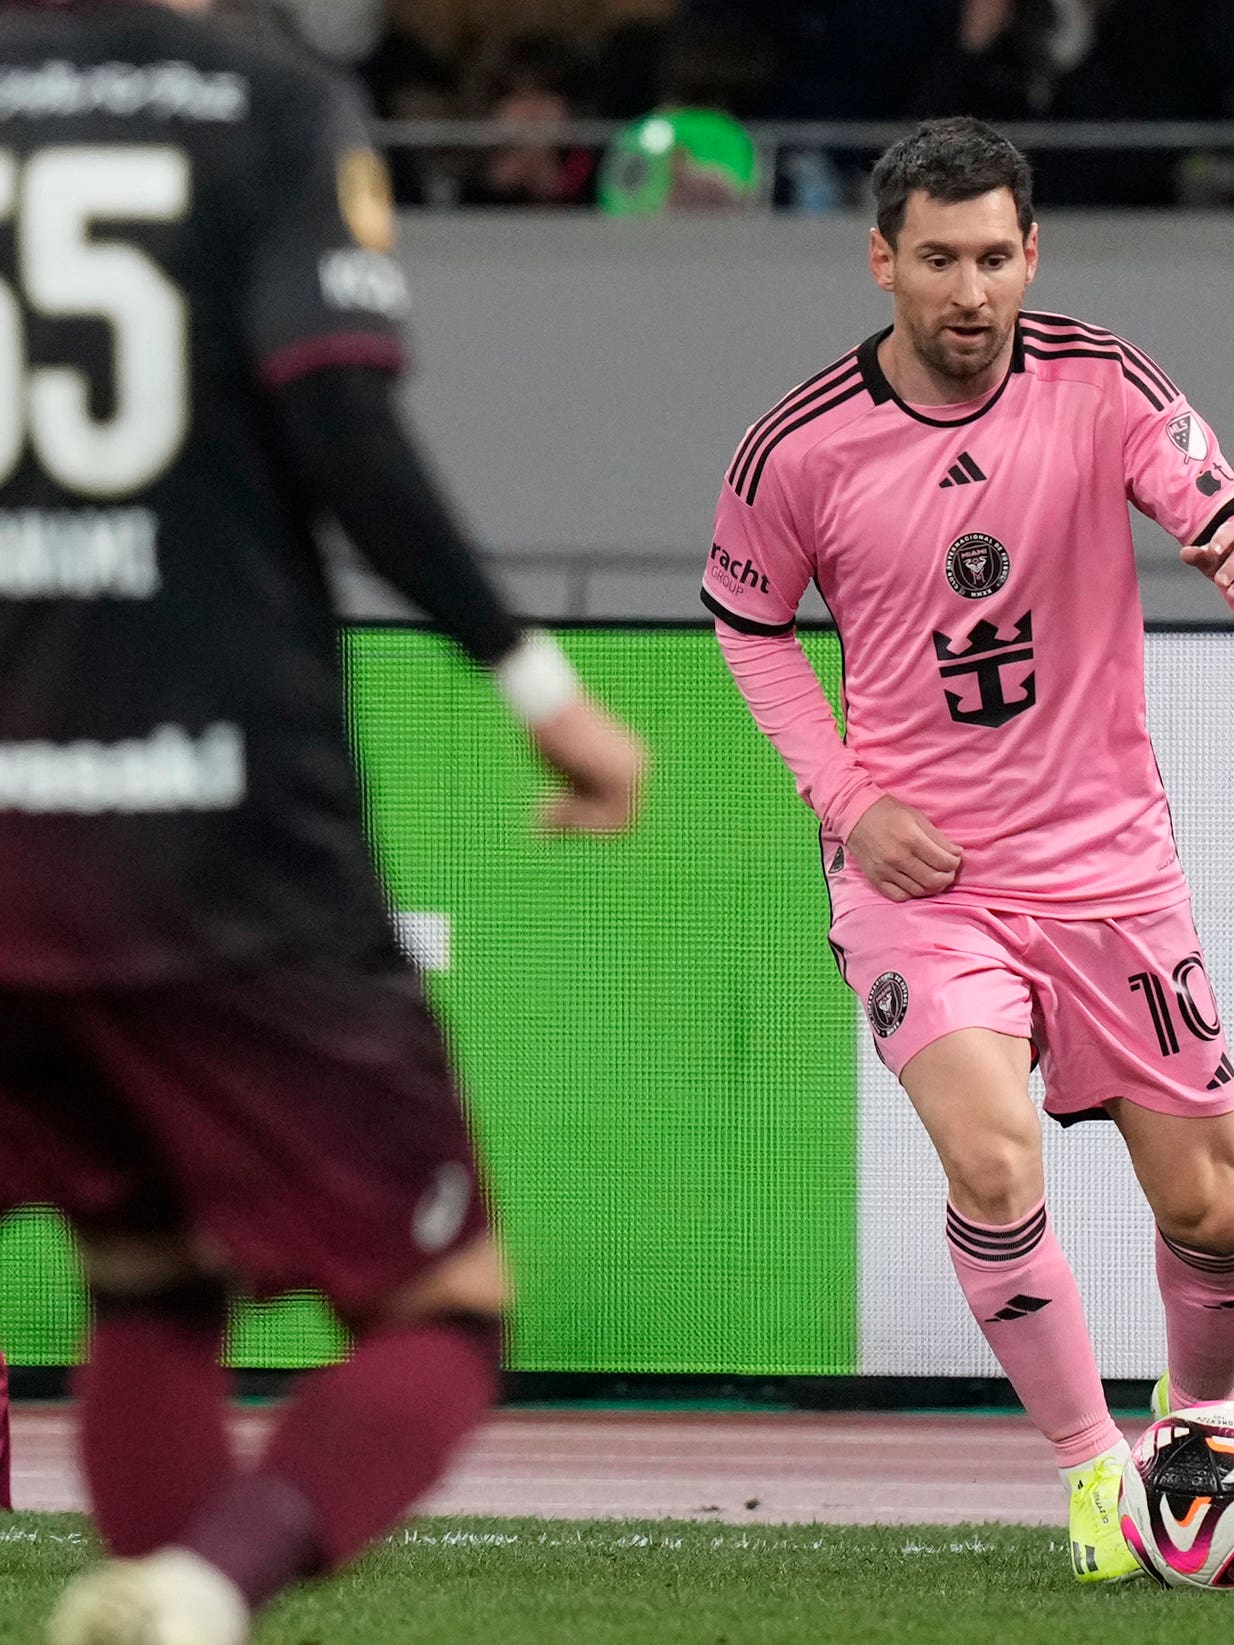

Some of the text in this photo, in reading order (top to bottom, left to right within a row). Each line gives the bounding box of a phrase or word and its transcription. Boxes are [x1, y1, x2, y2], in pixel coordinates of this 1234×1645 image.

[1169, 419, 1188, 435] MLS
[961, 548, 988, 559] MIAMI
[711, 565, 744, 596] GROUP
[1128, 951, 1221, 1057] 10
